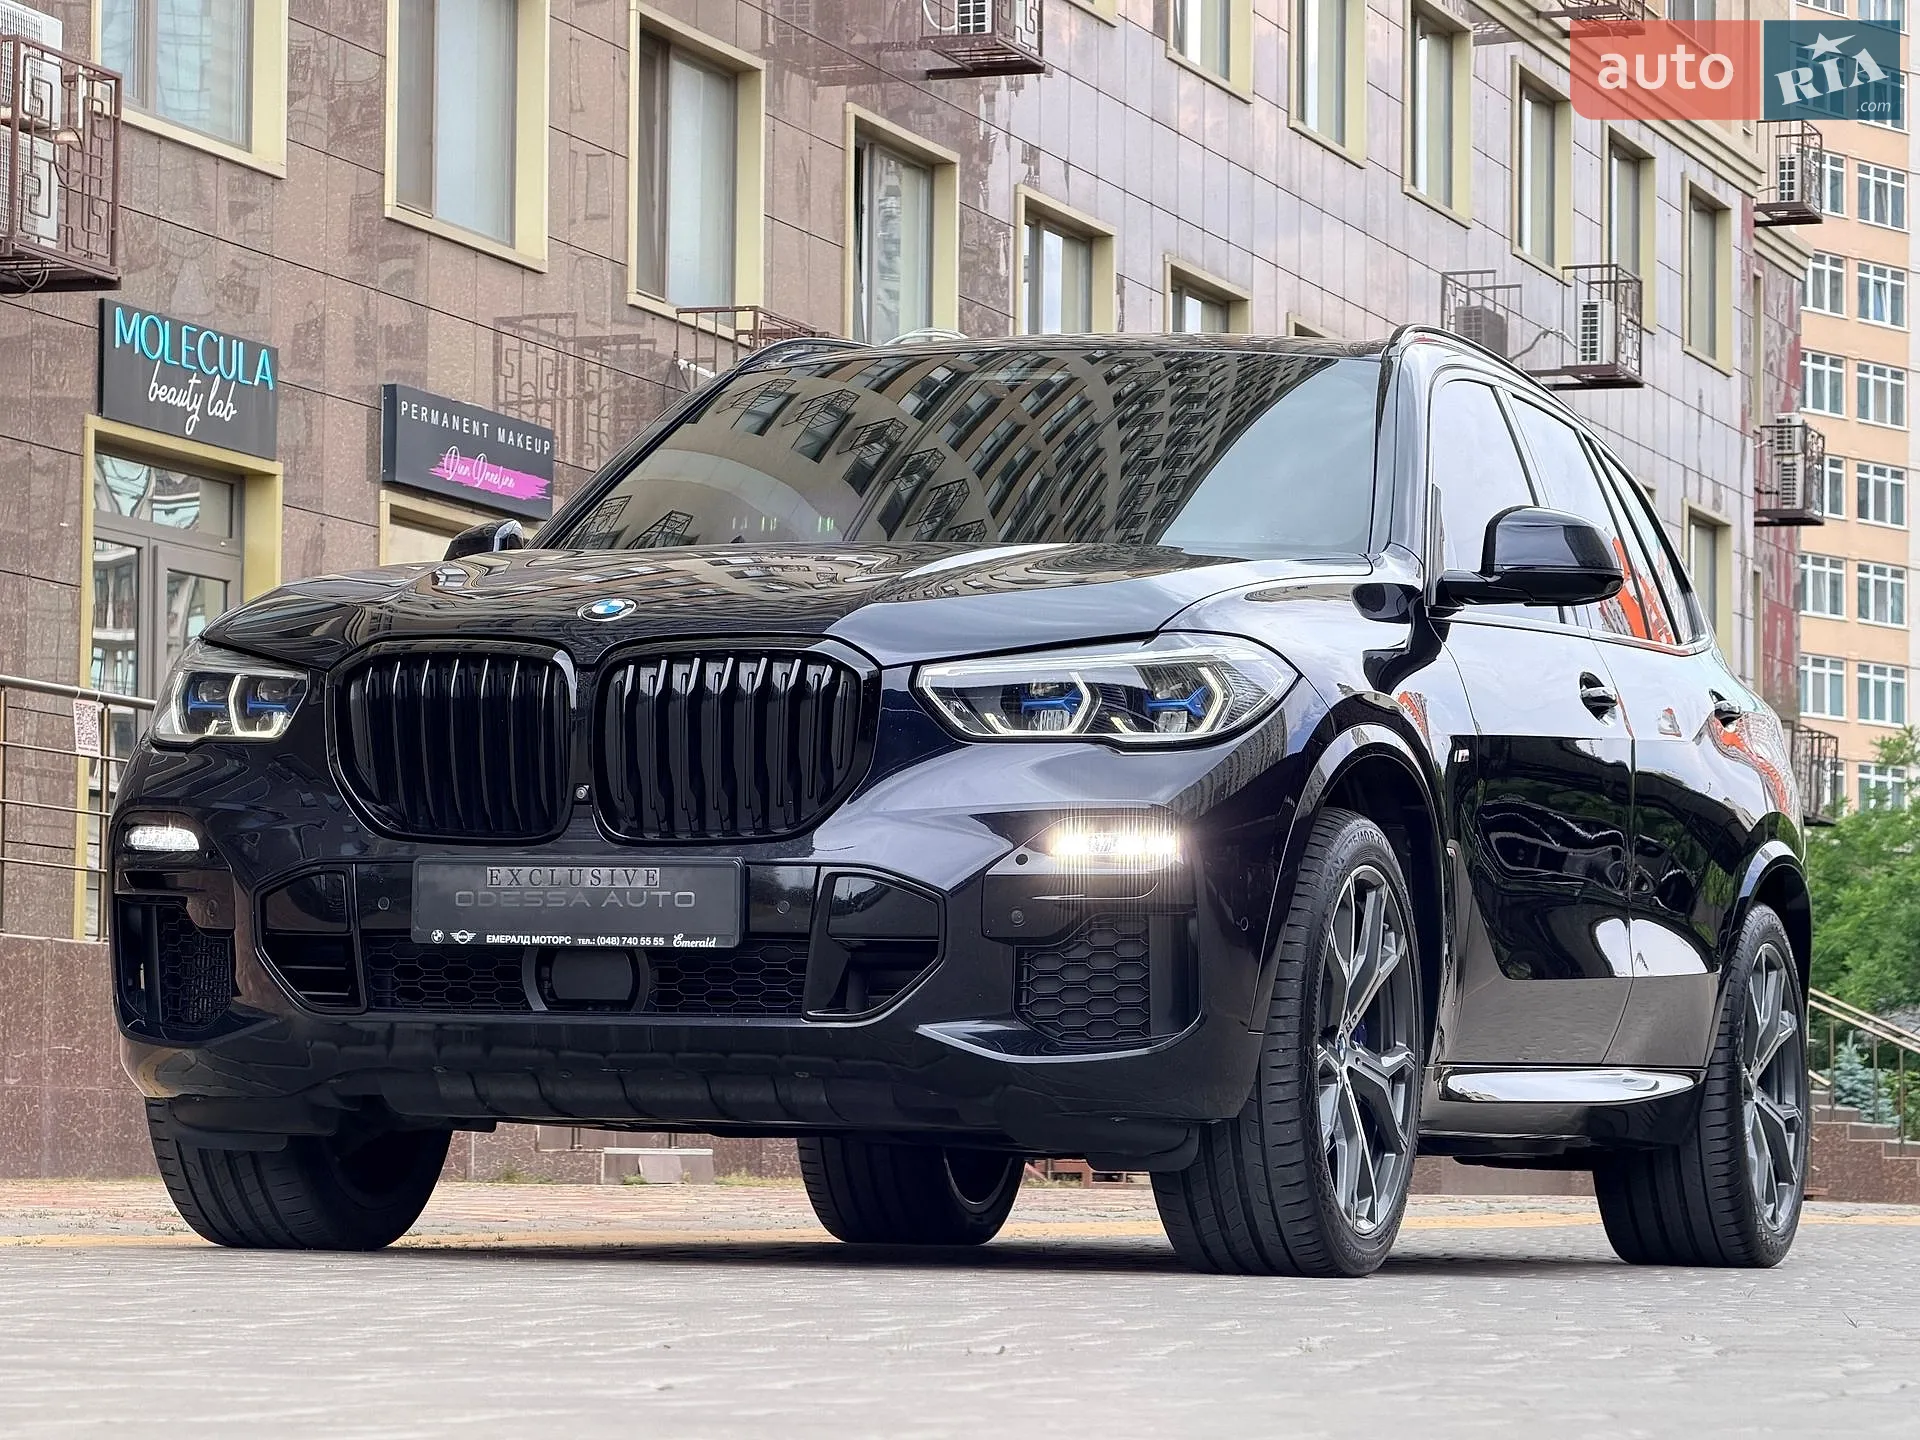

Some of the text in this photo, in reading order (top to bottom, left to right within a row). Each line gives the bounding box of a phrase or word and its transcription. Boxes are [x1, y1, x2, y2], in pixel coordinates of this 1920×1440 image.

[115, 306, 274, 391] MOLECULA
[148, 360, 237, 435] beauty lab
[401, 401, 550, 455] PERMANENT MAKEUP
[487, 868, 658, 886] EXCLUSIVE
[455, 891, 695, 907] ODESSA AUTO
[486, 935, 530, 945] ЕМЕРАЛД
[531, 935, 572, 945] МОТОРС
[596, 936, 620, 946] (048)
[621, 937, 638, 946] 740
[639, 937, 652, 946] 55
[652, 937, 665, 946] 55
[672, 933, 717, 948] Emerald
